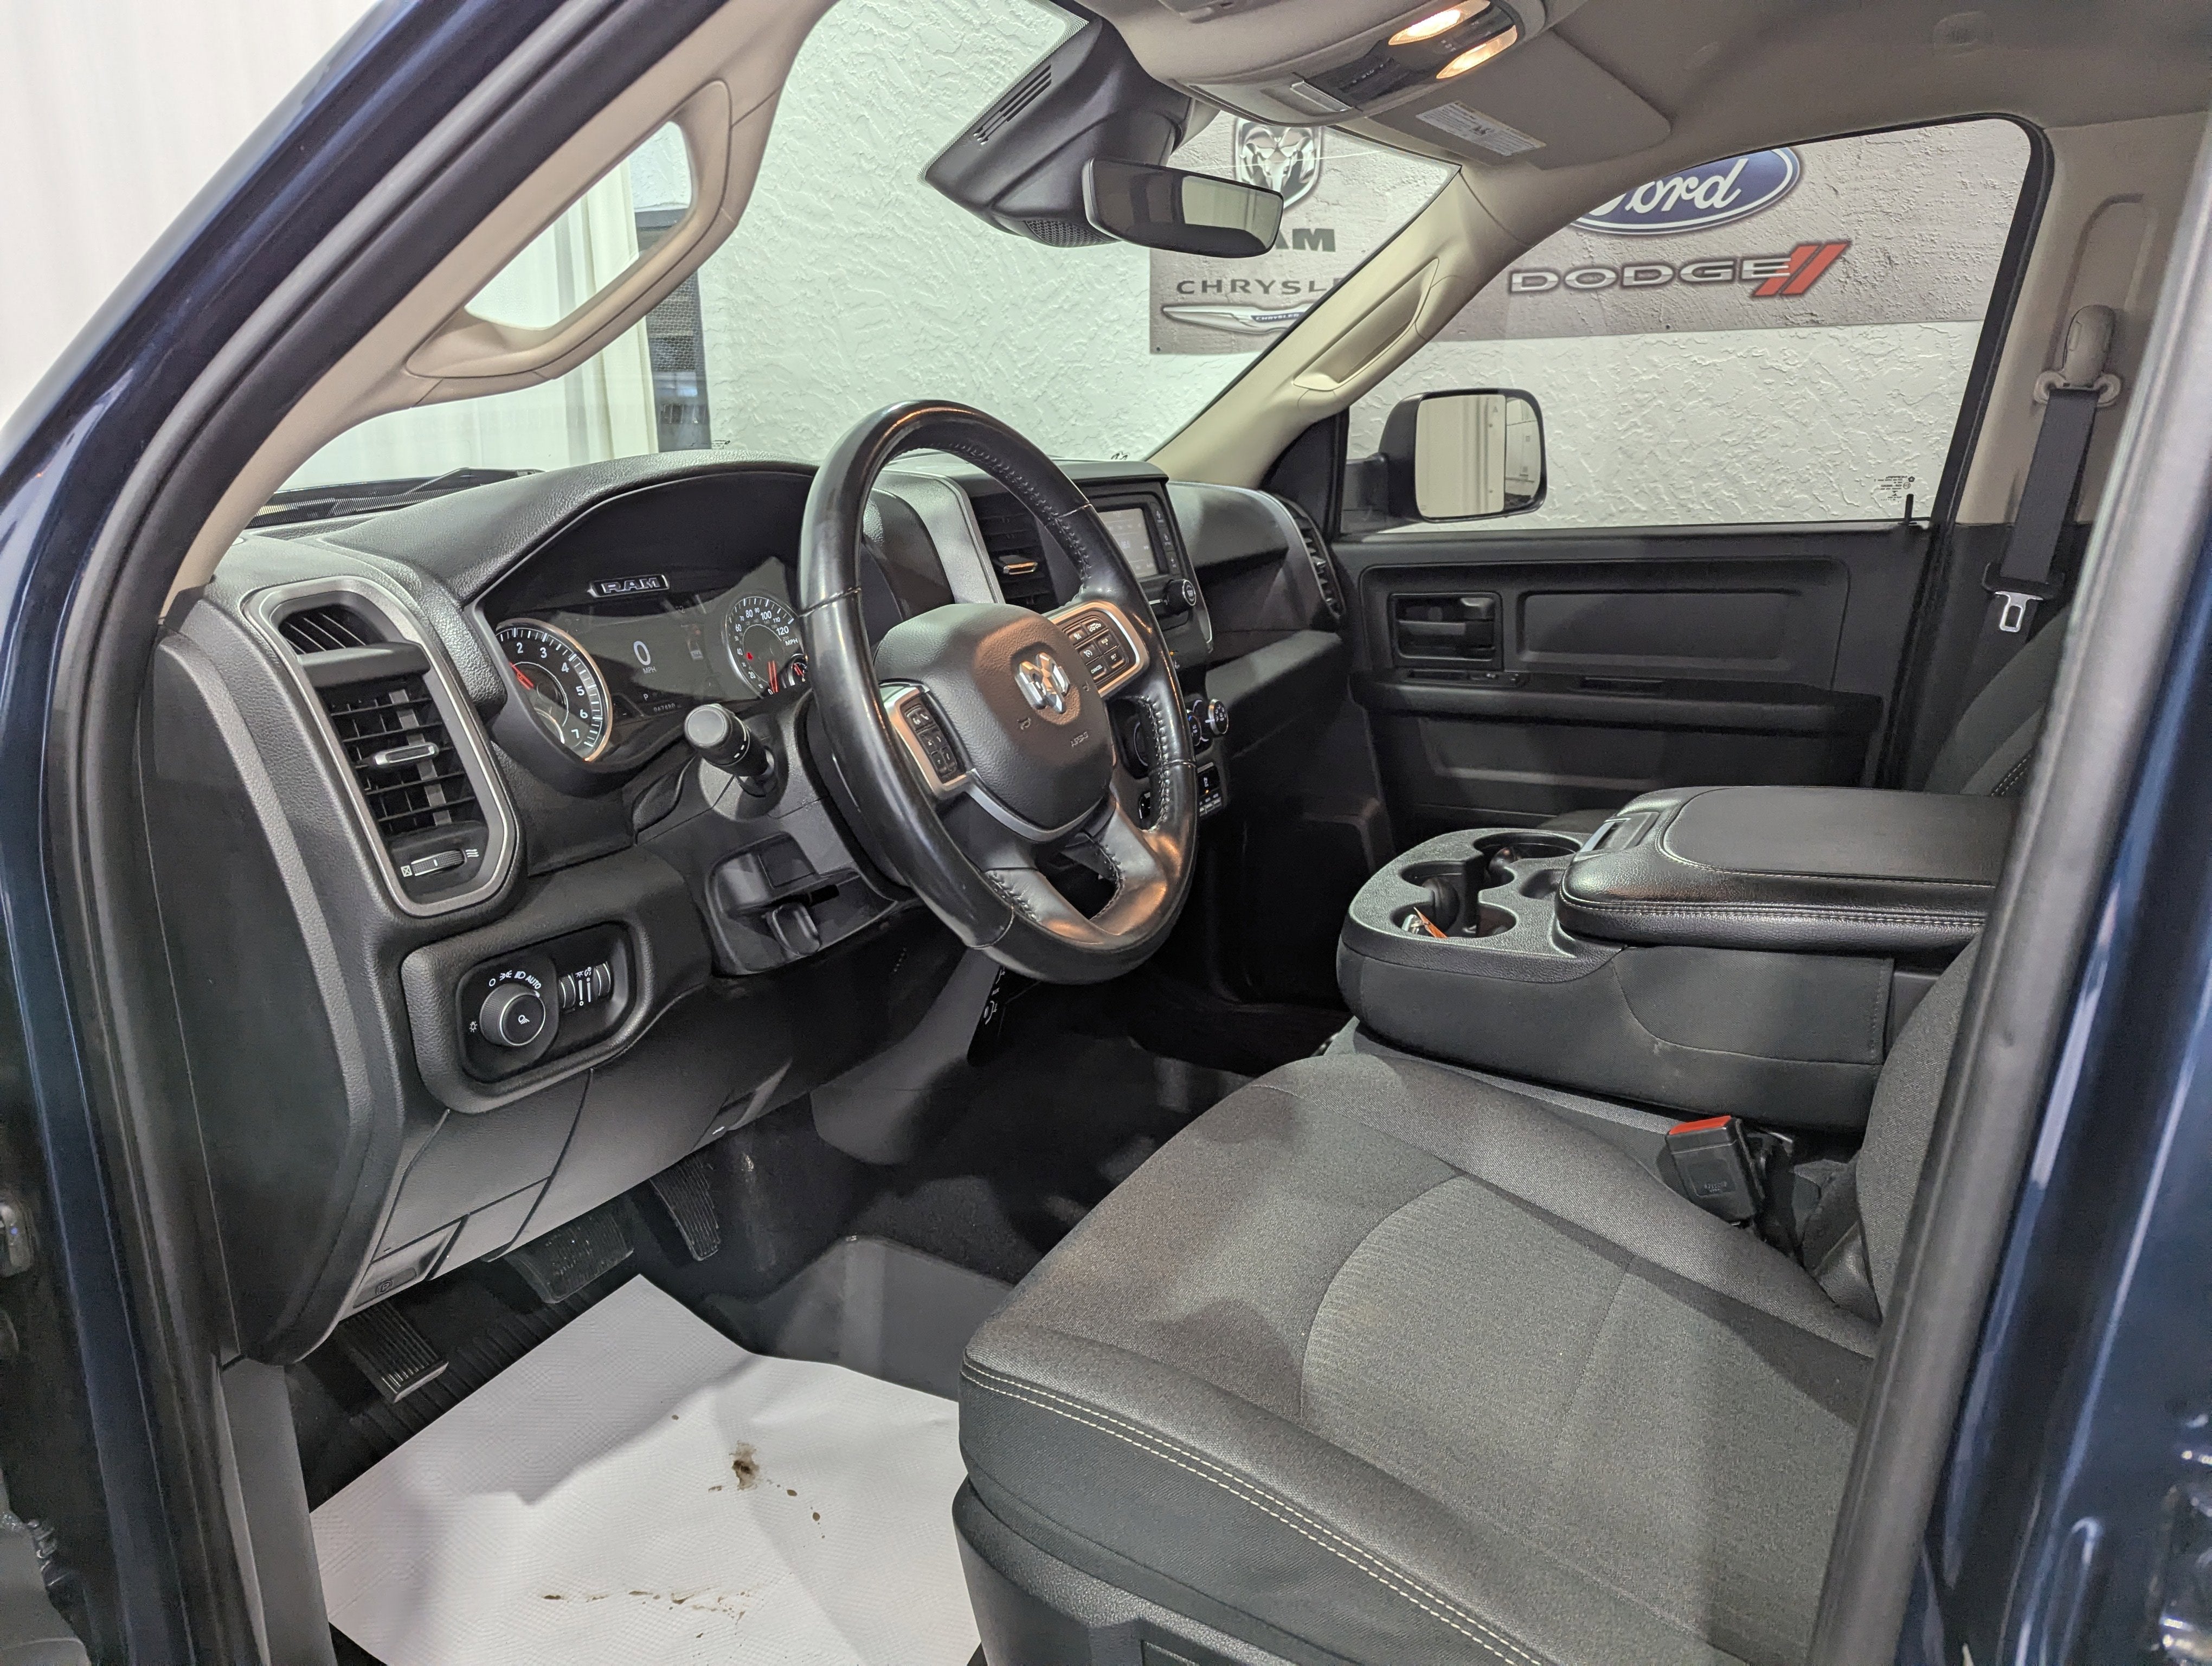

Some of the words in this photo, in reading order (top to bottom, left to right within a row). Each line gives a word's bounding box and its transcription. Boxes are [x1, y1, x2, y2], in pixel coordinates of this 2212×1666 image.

[1588, 158, 1748, 216] ord
[1510, 257, 1791, 293] DODGE
[1176, 277, 1341, 295] CHRYSL
[1256, 313, 1300, 321] CHRYSLER
[601, 577, 660, 593] RAM
[745, 609, 754, 618] 80
[760, 610, 772, 620] 100
[735, 624, 742, 632] 60
[776, 626, 789, 636] 120
[517, 642, 523, 653] 2
[785, 638, 799, 646] MPH
[539, 647, 547, 658] 3
[633, 640, 651, 665] 0
[561, 662, 569, 673] 4
[642, 666, 657, 674] MPH
[1091, 664, 1103, 674] CANCEL
[575, 685, 585, 696] 5
[580, 709, 588, 719] 6
[571, 728, 580, 739] 7
[525, 975, 542, 990] AUTO
